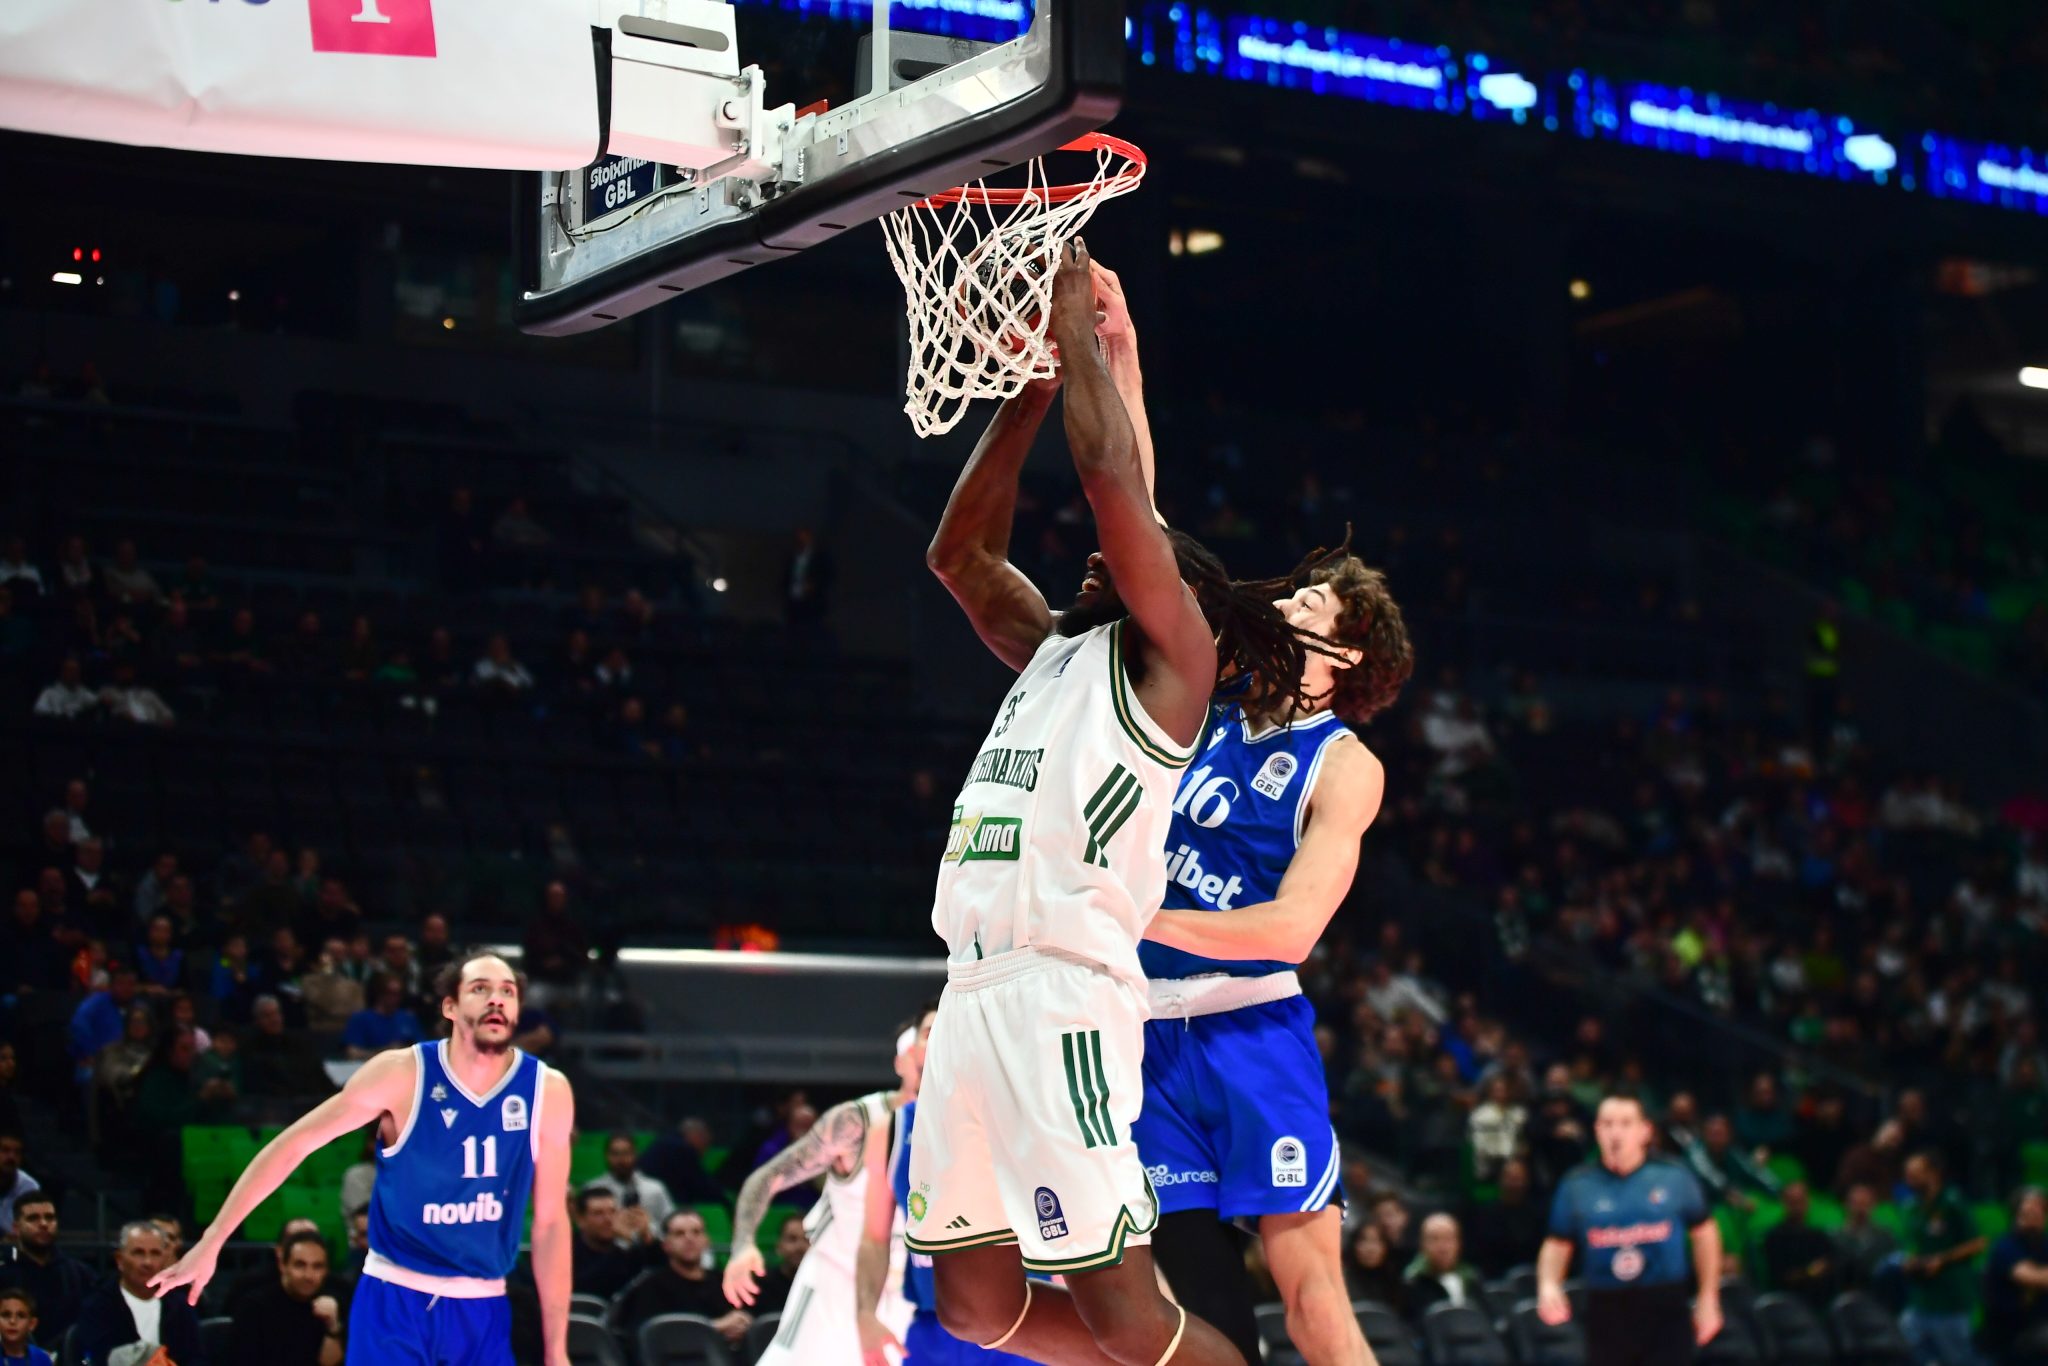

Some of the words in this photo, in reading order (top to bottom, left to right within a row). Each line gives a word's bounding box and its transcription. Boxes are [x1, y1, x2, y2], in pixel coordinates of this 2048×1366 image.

[590, 157, 650, 190] Stoixima
[605, 176, 635, 208] GBL
[1172, 765, 1240, 828] 16
[1255, 779, 1278, 797] GBL
[1165, 844, 1242, 911] ibet
[461, 1135, 498, 1178] 11
[1146, 1164, 1168, 1178] co
[1150, 1171, 1218, 1187] sources
[1276, 1174, 1302, 1183] GBL
[920, 1180, 930, 1193] bp
[423, 1192, 503, 1225] novib
[1042, 1224, 1067, 1239] GBL
